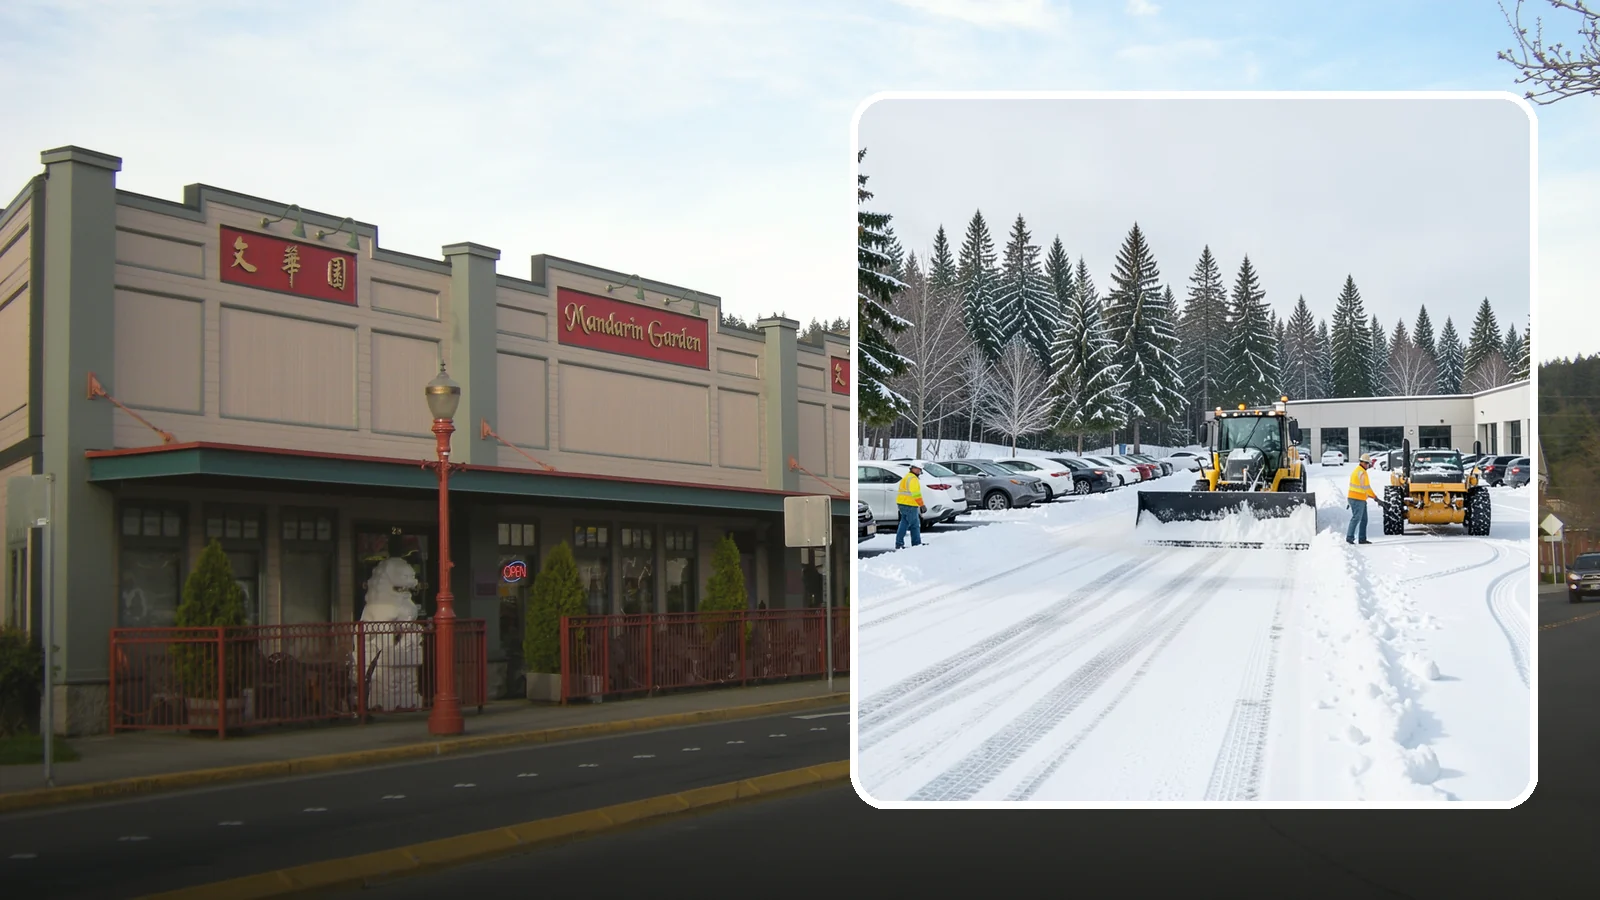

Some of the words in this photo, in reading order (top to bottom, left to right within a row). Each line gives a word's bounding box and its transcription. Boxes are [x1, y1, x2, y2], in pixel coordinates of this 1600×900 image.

[231, 236, 346, 290] 文華園
[564, 302, 644, 341] Mandarin
[648, 320, 701, 352] Garden
[503, 565, 527, 578] OPEN
